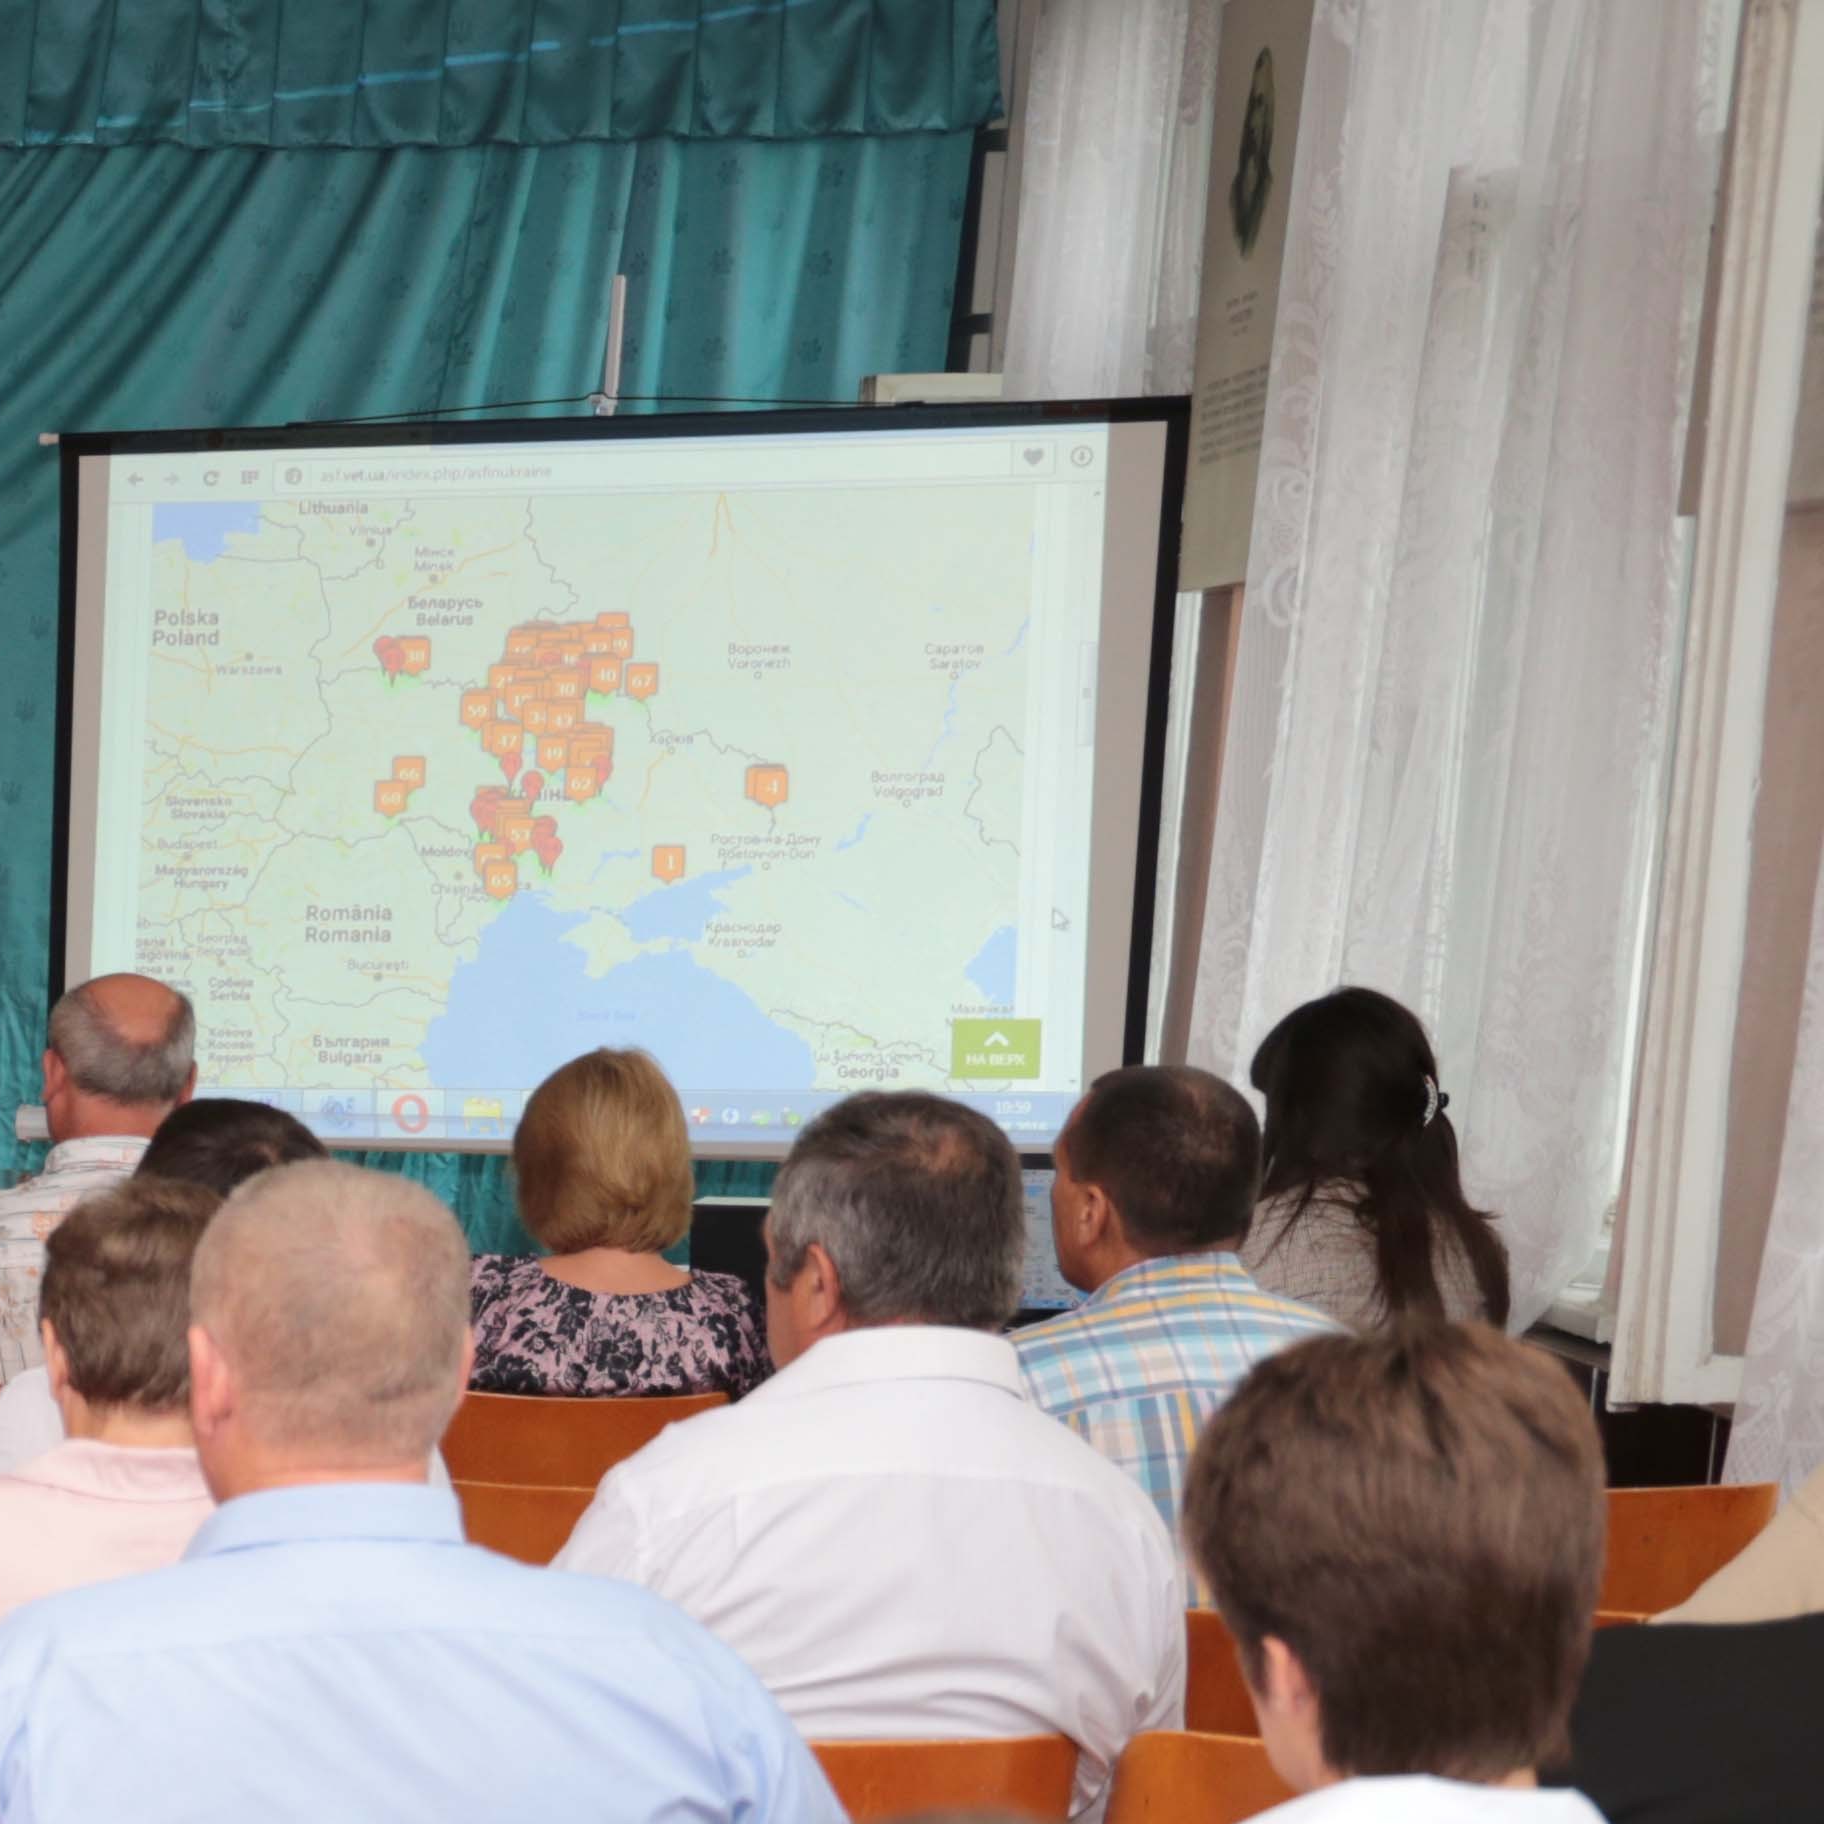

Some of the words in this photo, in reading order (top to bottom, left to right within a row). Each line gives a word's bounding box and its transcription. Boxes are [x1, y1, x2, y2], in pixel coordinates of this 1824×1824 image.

[320, 465, 552, 483] asf.vet.ua/index.php/asfinukraine
[299, 501, 368, 515] Lithuania
[349, 524, 392, 536] Vilnius
[414, 559, 453, 572] Minsk
[408, 595, 483, 611] Беларусь
[154, 609, 220, 626] Polska
[416, 613, 473, 626] Belarus
[152, 629, 220, 646] Poland
[727, 644, 791, 655] Воронеж
[925, 644, 983, 657] Саратов
[728, 657, 791, 669] Voronezh
[929, 657, 981, 669] Saratov
[216, 664, 282, 676] Warszawa
[597, 669, 616, 682] 40
[632, 675, 651, 687] 67
[498, 734, 517, 747] 47
[649, 734, 693, 746] Харків
[544, 746, 563, 759] 49
[399, 767, 420, 780] 66
[872, 772, 944, 786] Волгоград
[571, 777, 590, 790] 62
[874, 785, 943, 799] Volgograd
[165, 795, 232, 807] Slovensko
[170, 808, 226, 820] Slovakia
[157, 839, 218, 852] Budapest
[711, 834, 820, 847] Ростов-на-Дону
[665, 855, 675, 870] 1
[155, 864, 249, 878] Magyarország
[174, 877, 229, 891] Hungary
[491, 874, 511, 888] 65
[306, 904, 392, 922] România
[305, 926, 392, 943] Romania
[705, 923, 782, 937] Краснодар
[708, 936, 777, 948] Krasnodar
[348, 959, 409, 973] București
[210, 990, 251, 1002] Serbia
[209, 1028, 253, 1039] Kosova
[312, 1035, 390, 1051] България
[318, 1050, 382, 1066] Bulgaria
[967, 1054, 986, 1065] НА
[989, 1054, 1025, 1066] ВЕРХ
[838, 1065, 899, 1081] Georgia
